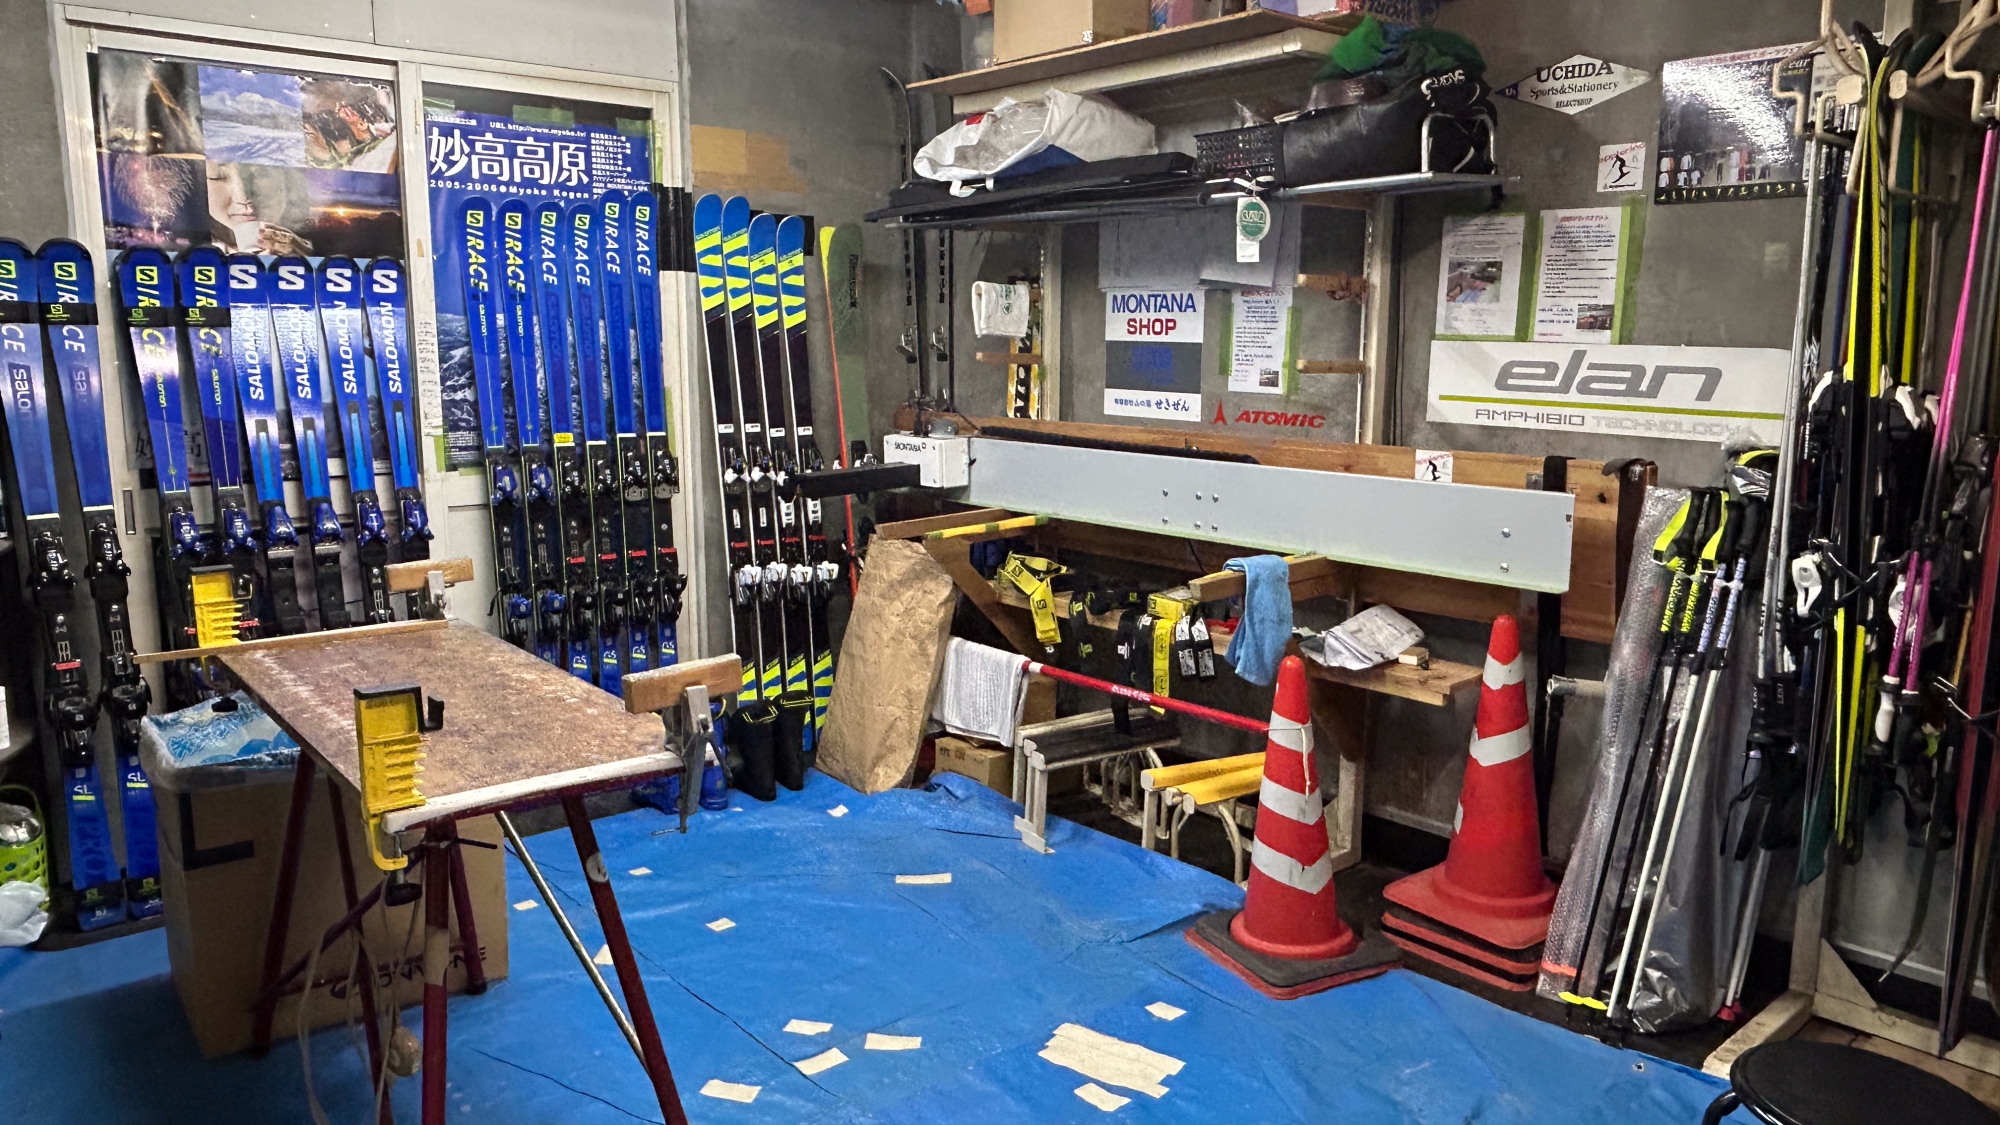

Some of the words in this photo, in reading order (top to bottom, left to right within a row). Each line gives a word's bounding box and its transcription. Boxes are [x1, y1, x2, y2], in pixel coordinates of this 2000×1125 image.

[1536, 62, 1614, 83] UCHIDA
[489, 121, 506, 129] URL
[428, 126, 590, 187] 妙高高原
[509, 186, 547, 196] Myoko
[553, 189, 589, 199] Kogen
[230, 264, 257, 289] S
[278, 266, 305, 290] S
[326, 268, 352, 292] S
[373, 269, 397, 293] S
[1112, 293, 1197, 313] MONTANA
[1126, 318, 1177, 335] SHOP
[334, 300, 358, 394] SALOMON
[380, 302, 402, 393] SALOMON
[1495, 349, 1723, 402] elan
[1235, 410, 1327, 428] ATOMIC
[1475, 408, 1585, 426] AMPHIBIO
[127, 772, 147, 782] SL
[73, 785, 92, 795] SL
